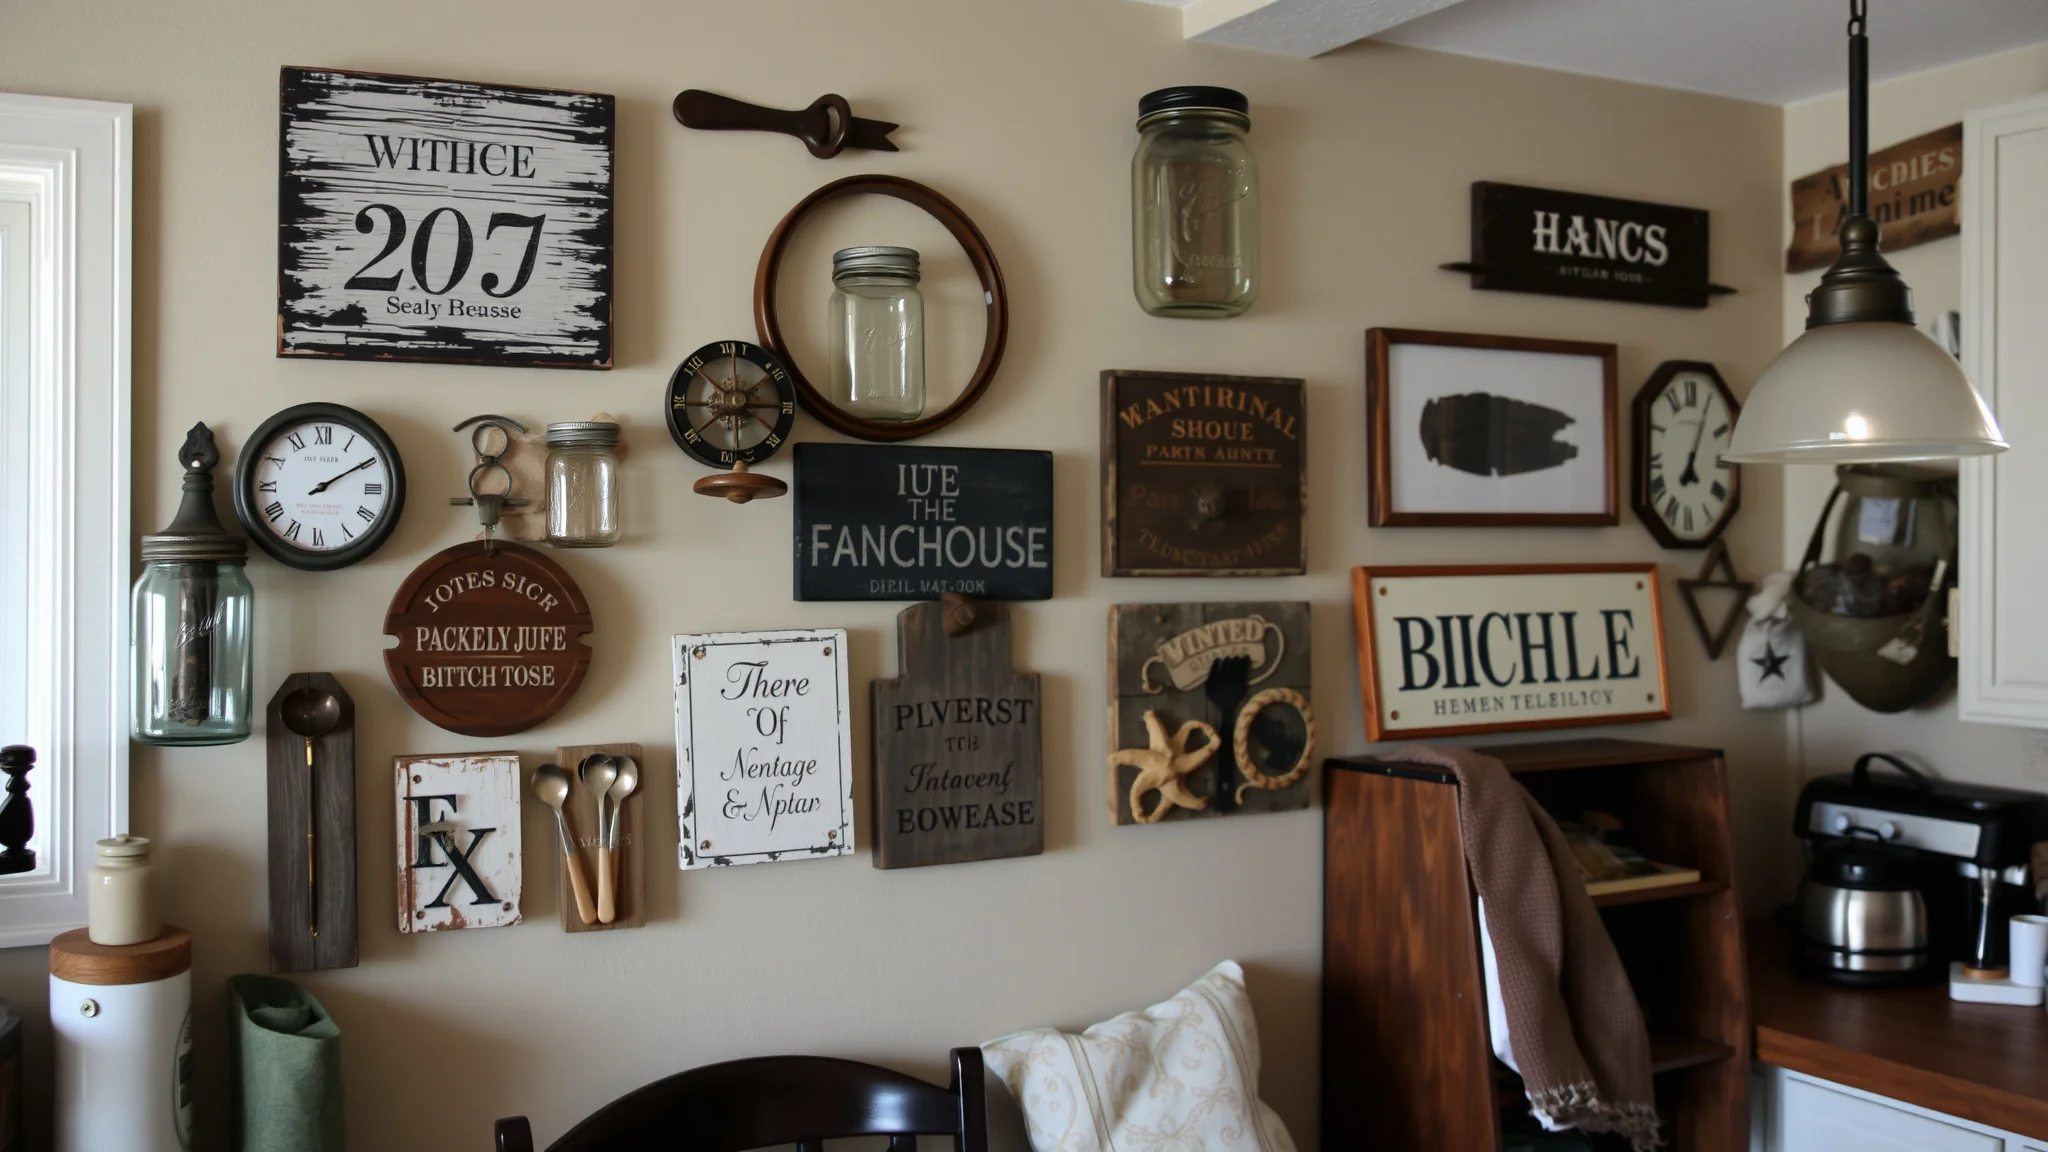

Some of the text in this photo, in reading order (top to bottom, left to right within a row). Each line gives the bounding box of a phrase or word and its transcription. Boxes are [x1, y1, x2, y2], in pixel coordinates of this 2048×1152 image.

[344, 203, 546, 298] 207
[1532, 209, 1669, 267] HANCS
[386, 296, 441, 320] Sealy
[907, 498, 957, 521] THE
[811, 523, 1049, 568] FANCHOUSE
[416, 625, 567, 653] PACKELY JUFE
[421, 665, 556, 688] BITTCH TOSE
[720, 660, 810, 700] There
[746, 705, 790, 745] Of
[894, 697, 1034, 733] PLVERST
[897, 800, 1035, 835] BOWEASE
